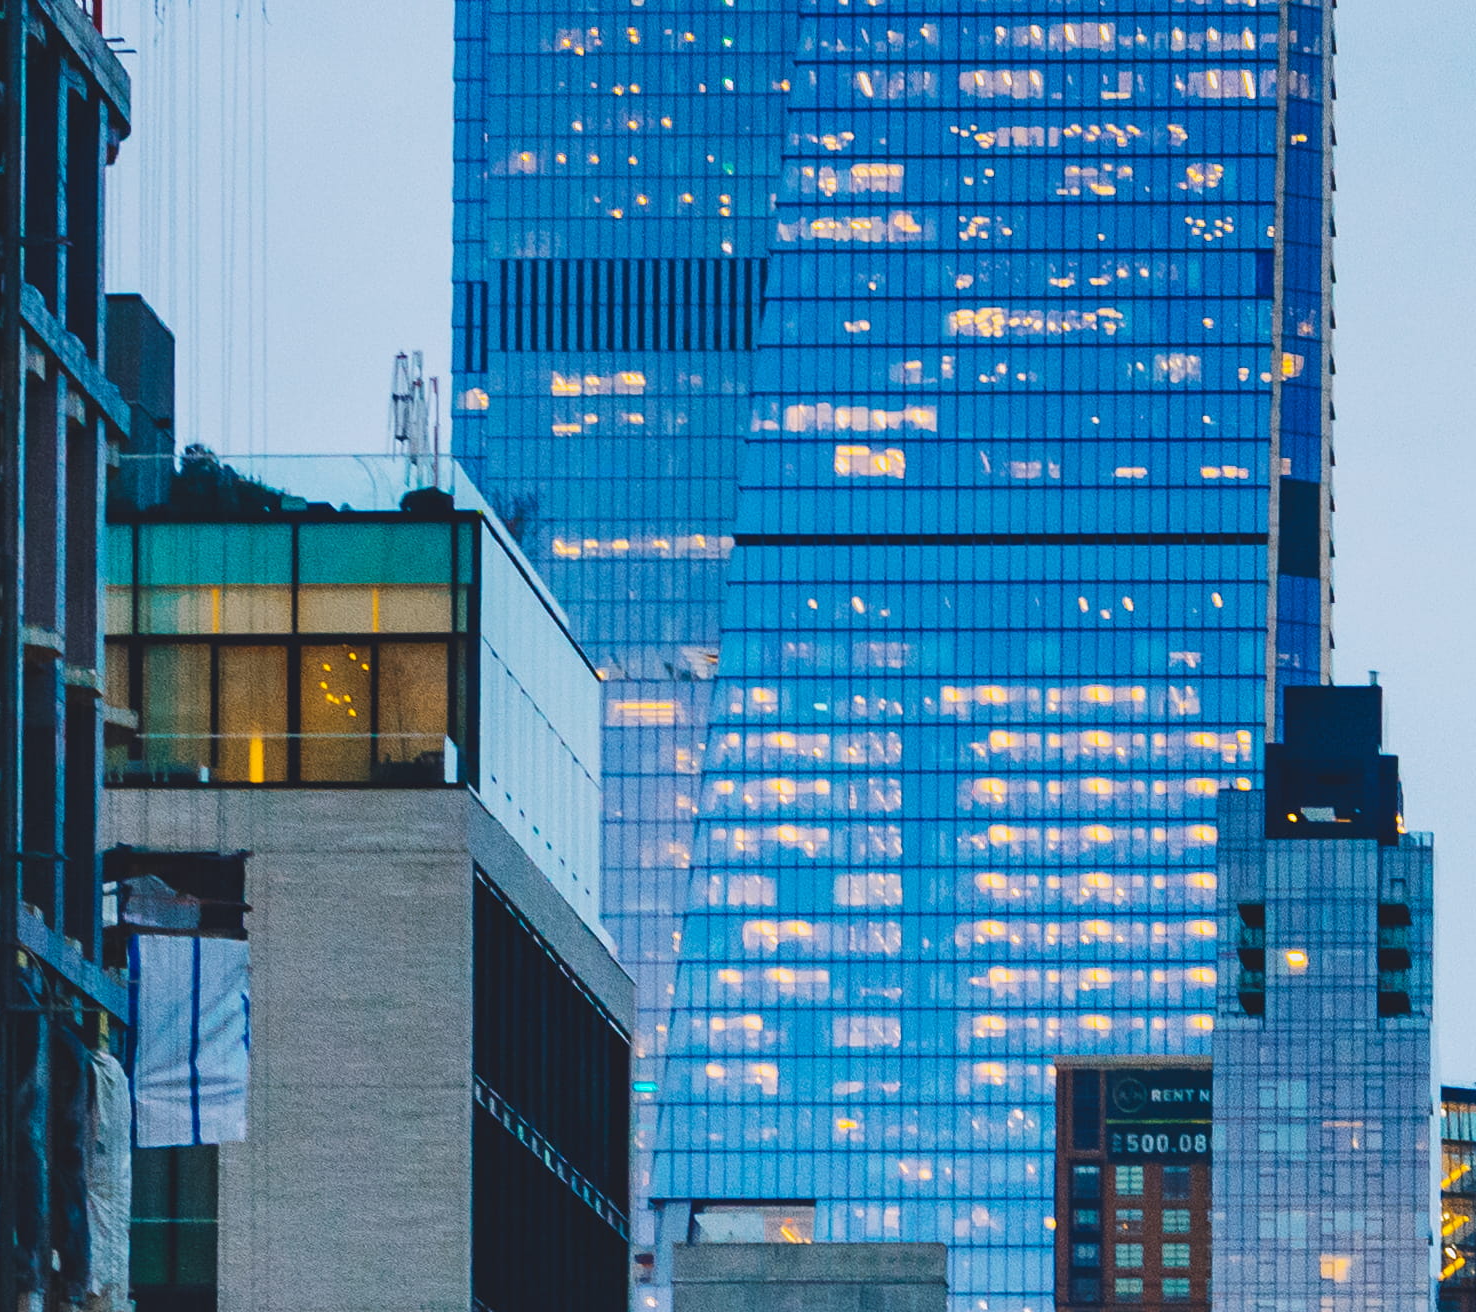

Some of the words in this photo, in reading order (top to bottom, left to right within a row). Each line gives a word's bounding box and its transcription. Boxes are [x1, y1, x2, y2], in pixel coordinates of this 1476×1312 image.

[1151, 1088, 1195, 1102] RENT
[1199, 1088, 1211, 1102] N
[1127, 1133, 1212, 1153] 500.08
